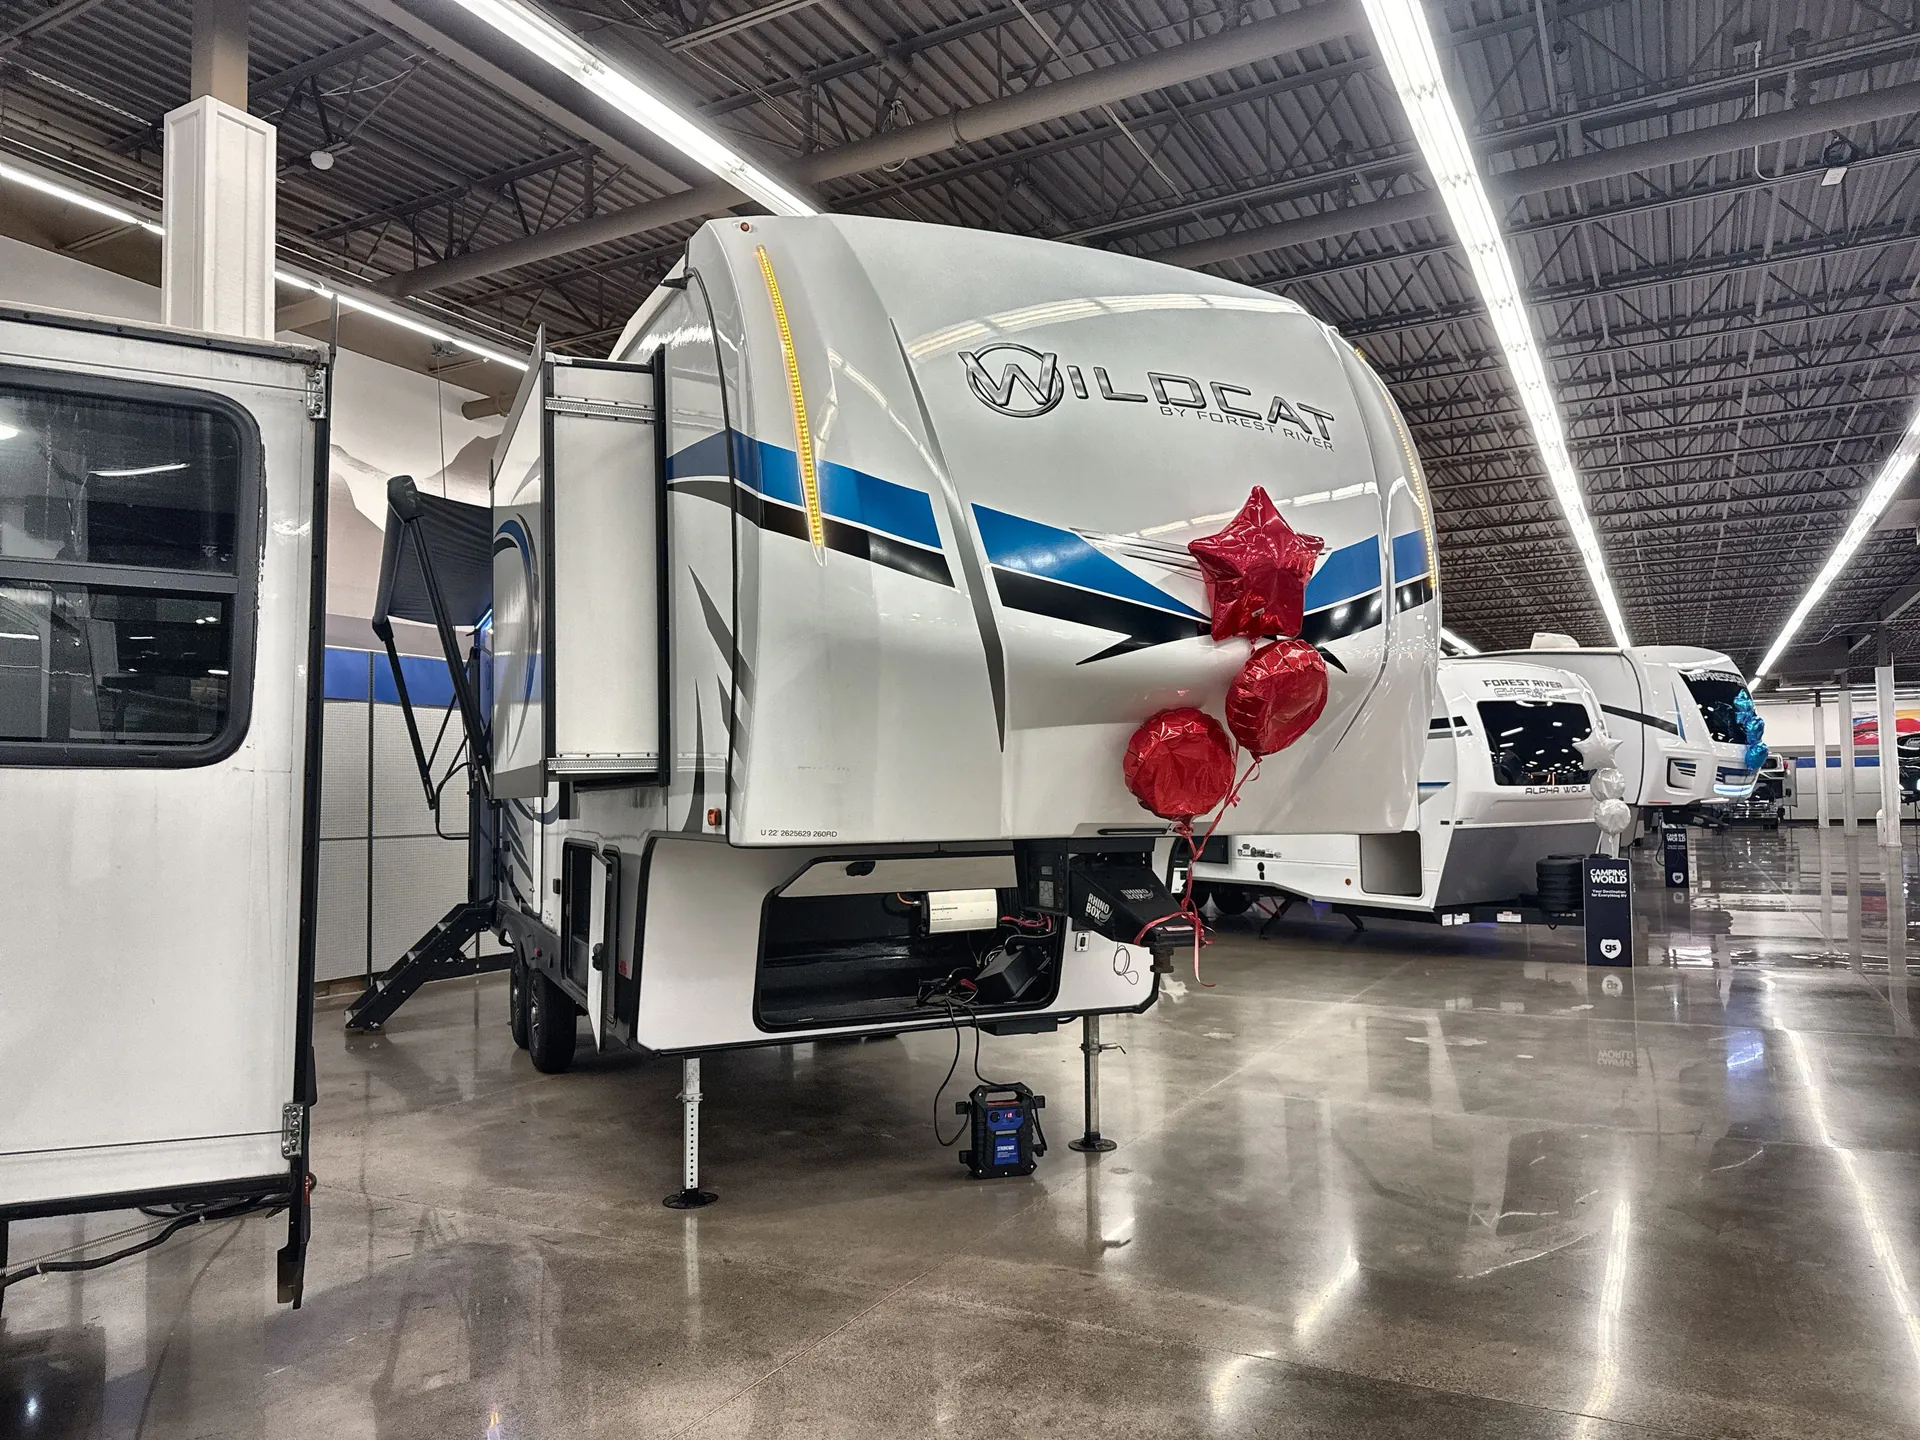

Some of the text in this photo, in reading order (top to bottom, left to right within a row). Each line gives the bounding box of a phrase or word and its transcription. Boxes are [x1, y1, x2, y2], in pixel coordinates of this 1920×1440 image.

[958, 342, 1335, 441] WILDCAT
[1160, 405, 1335, 452] BY FOREST RIVER
[1482, 679, 1563, 689] FOREST RIVER
[1525, 785, 1586, 795] ALPHA WOLF
[1590, 868, 1627, 877] CAMPING
[1590, 876, 1628, 884] WORLD
[1087, 892, 1110, 914] RHINO
[1085, 902, 1101, 920] BOX
[1604, 944, 1617, 953] gs
